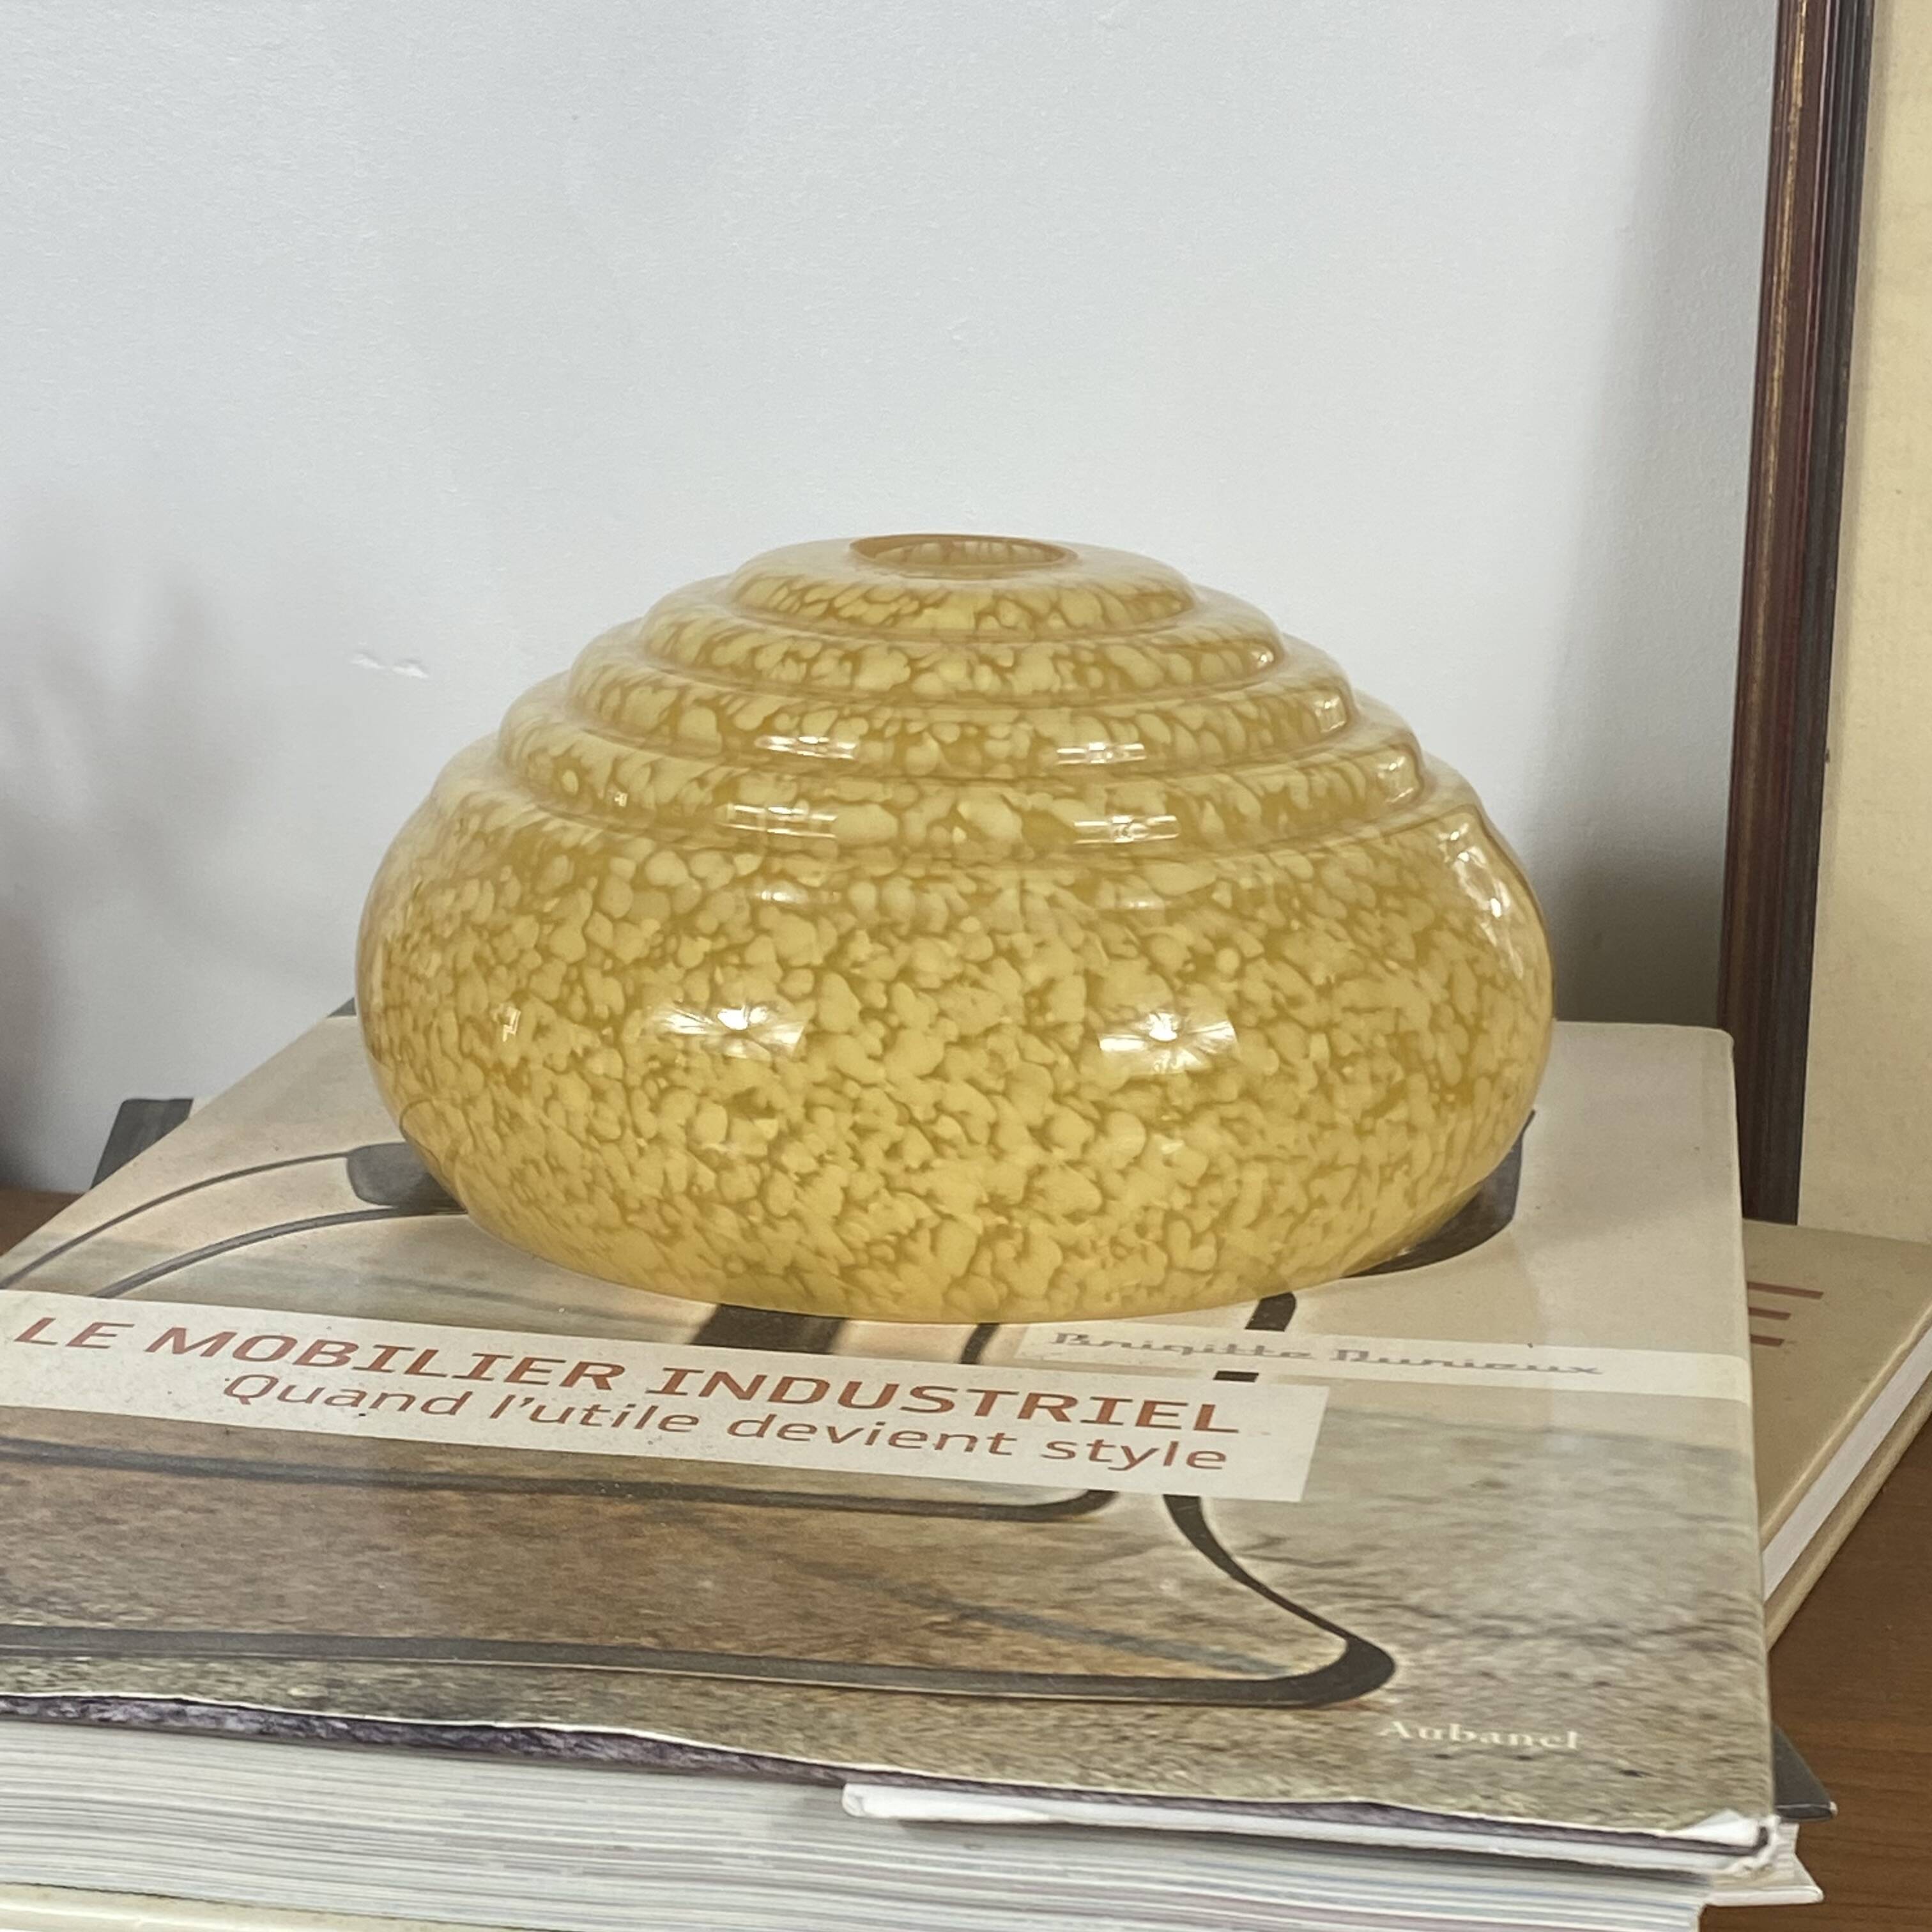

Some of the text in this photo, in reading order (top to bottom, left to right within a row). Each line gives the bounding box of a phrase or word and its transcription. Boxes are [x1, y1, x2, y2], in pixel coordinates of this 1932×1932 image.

[13, 1317, 1239, 1434] LE MOBILIER INDUSTRIEL
[1054, 1332, 1316, 1360] Brigitte
[224, 1374, 1227, 1471] Quand l’utile devient style
[1376, 1721, 1579, 1749] Aubanel
